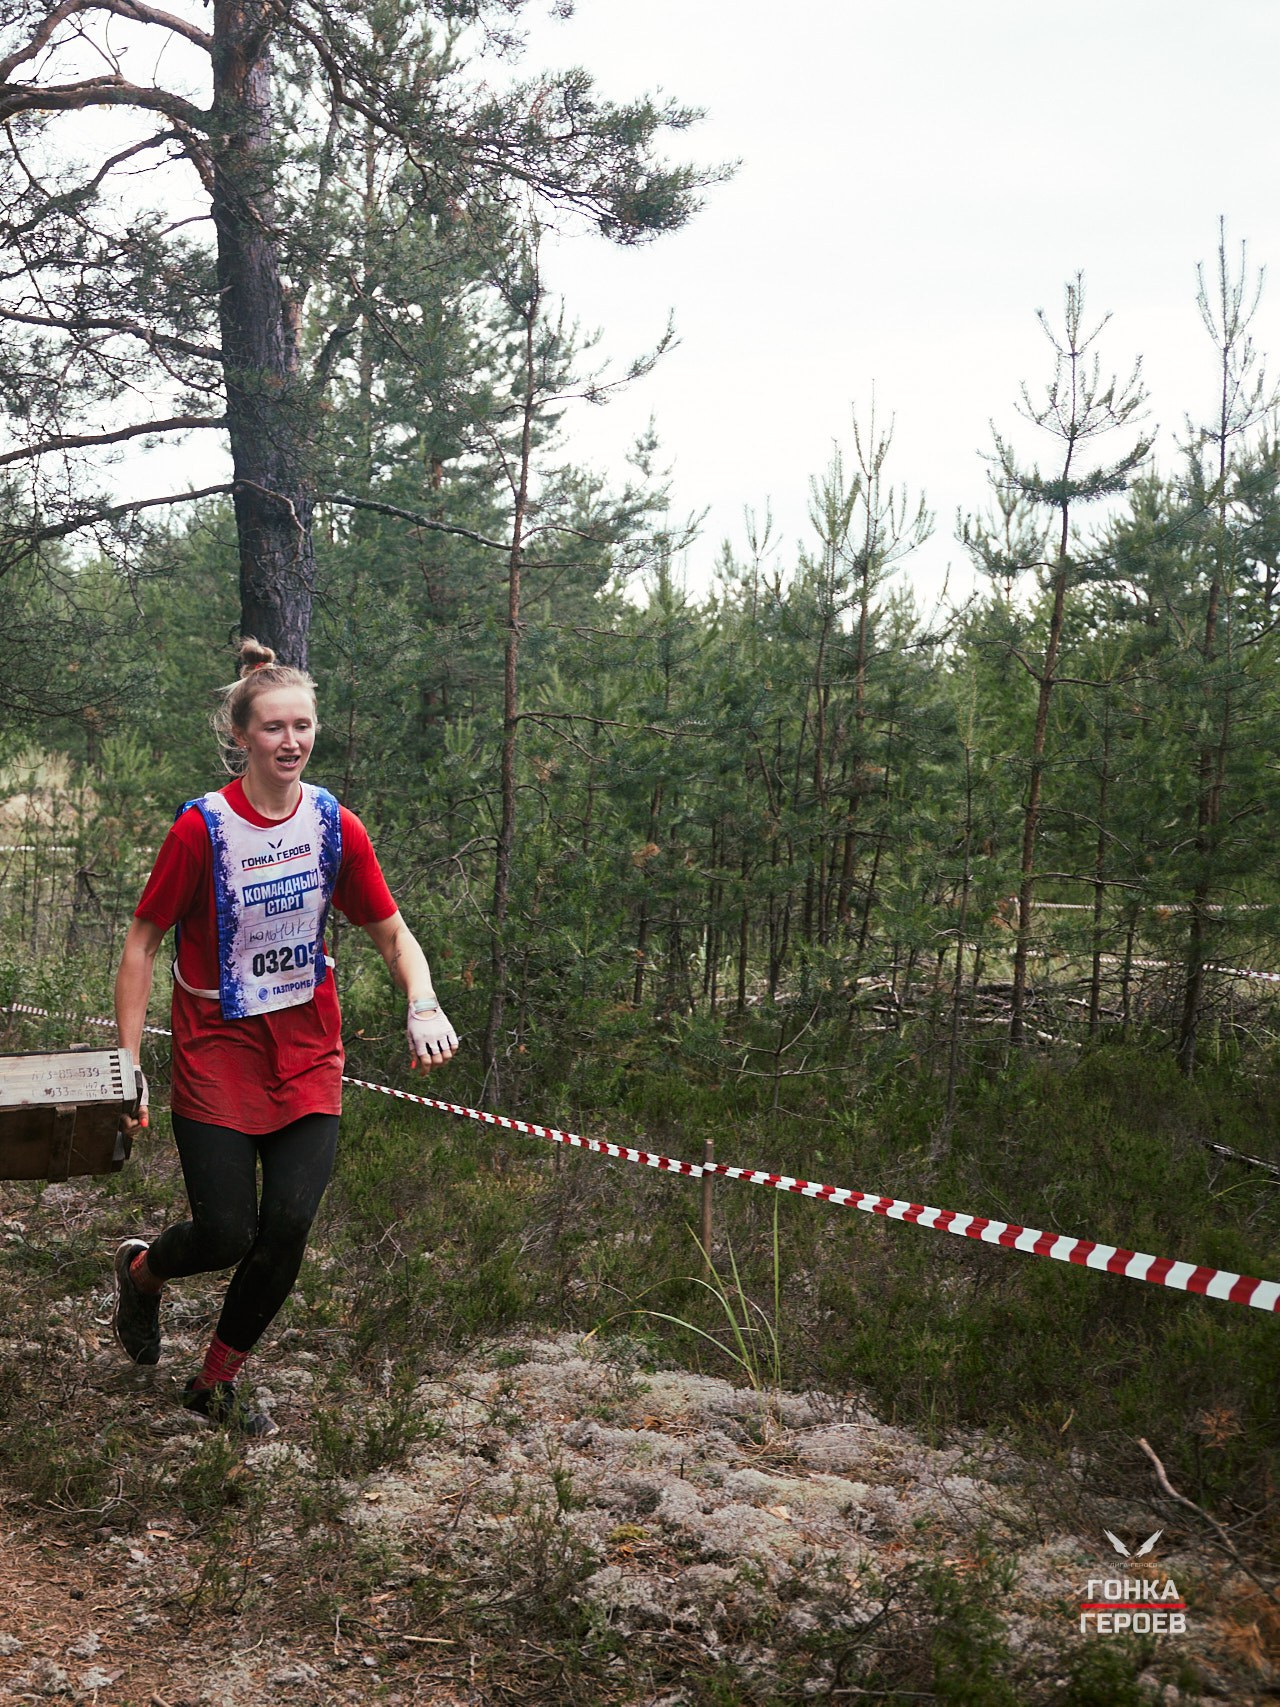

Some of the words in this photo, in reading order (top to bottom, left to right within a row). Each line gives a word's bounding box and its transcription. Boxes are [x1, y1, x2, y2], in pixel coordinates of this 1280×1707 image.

[241, 854, 274, 868] ГОНКА
[277, 843, 311, 860] ГЕРОЕВ
[244, 869, 319, 904] КОМАНДНЫЙ
[266, 894, 301, 915] СТАРТ
